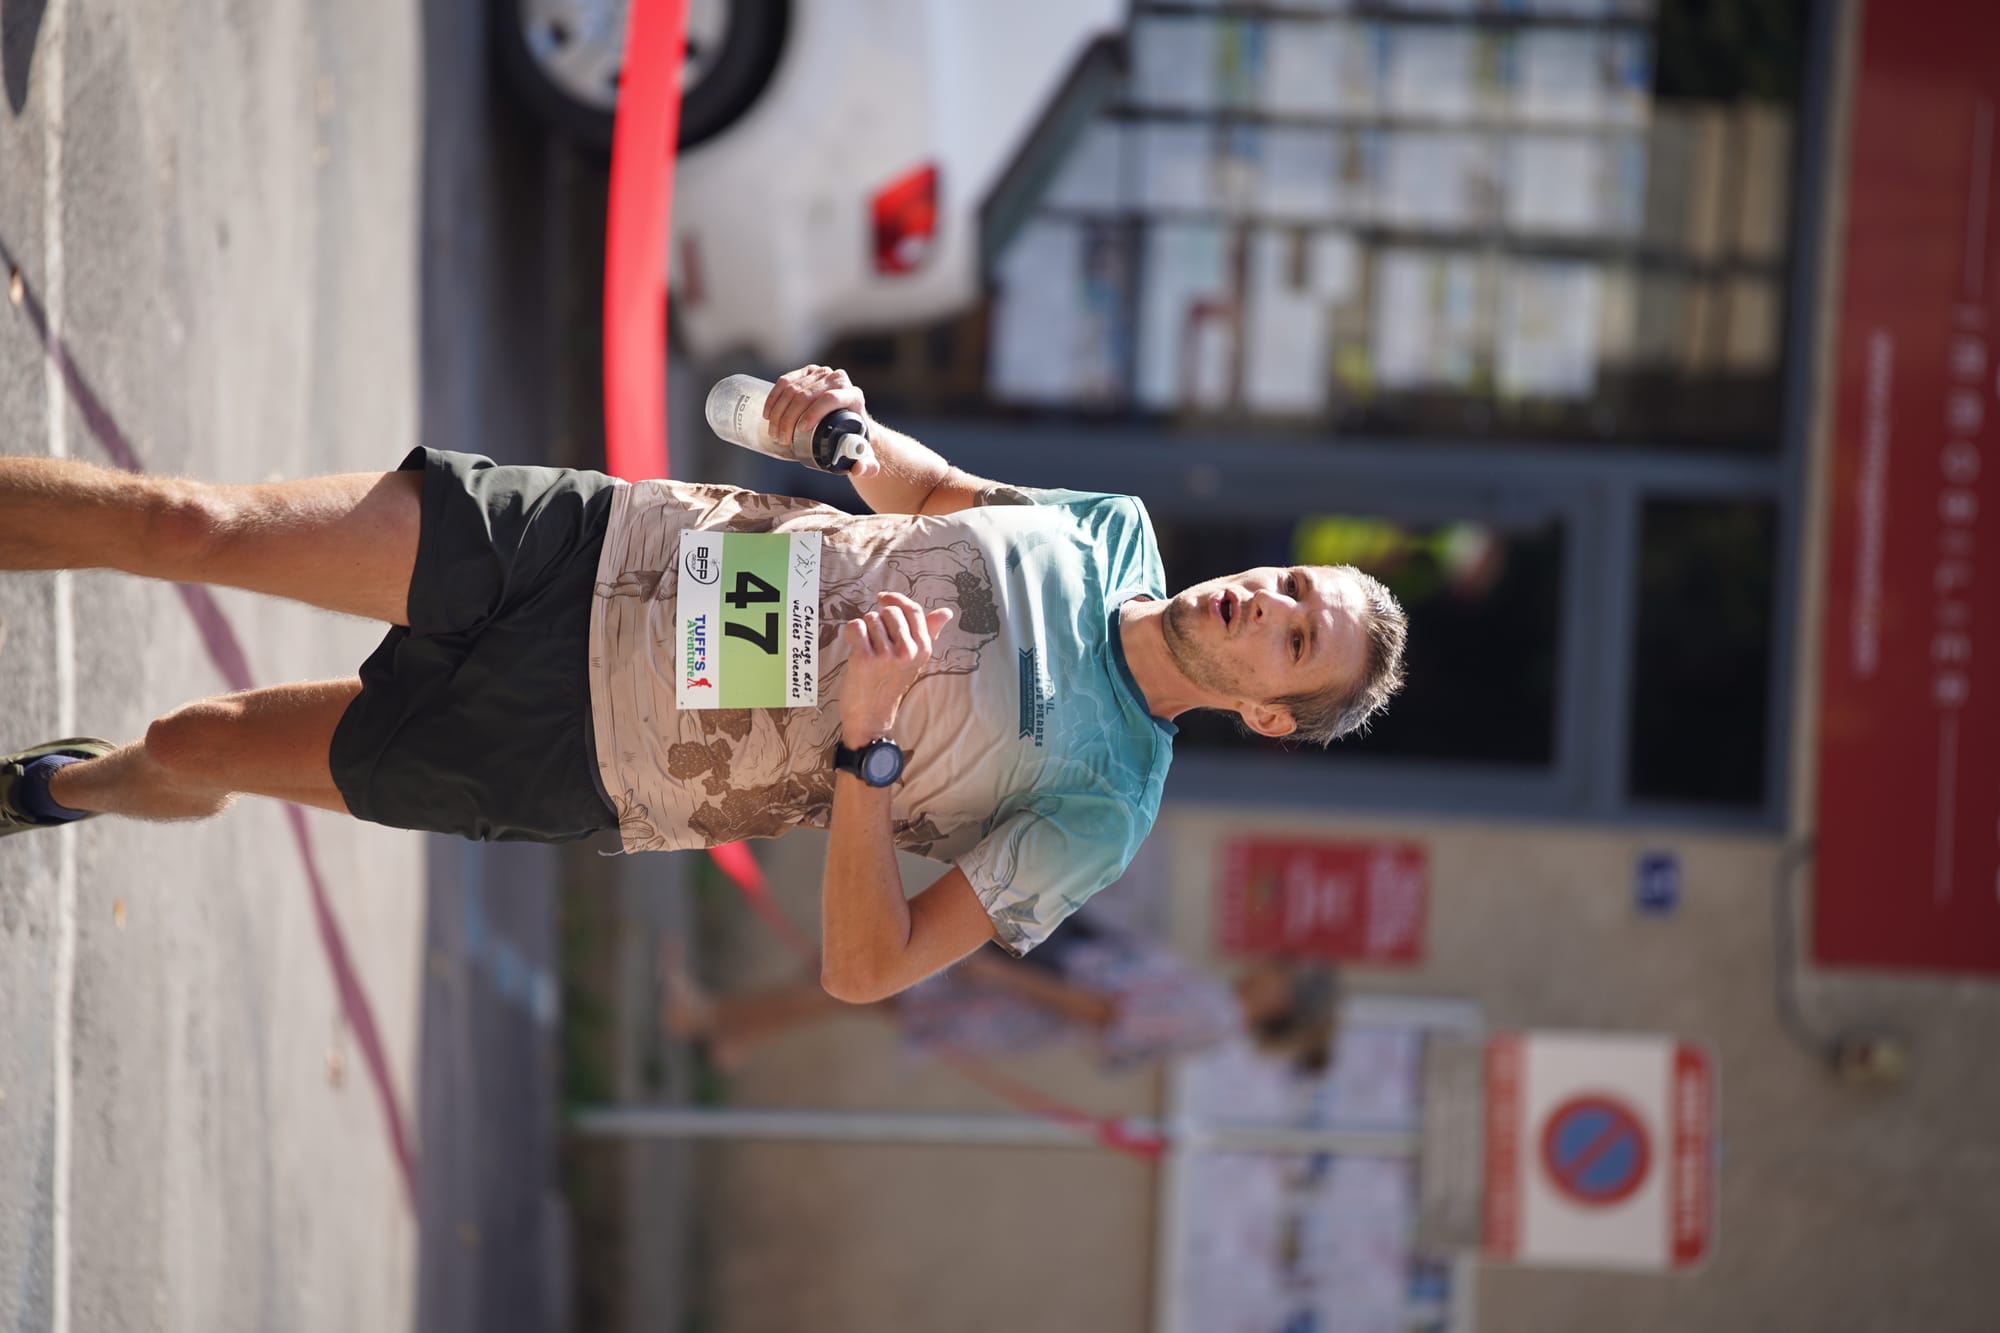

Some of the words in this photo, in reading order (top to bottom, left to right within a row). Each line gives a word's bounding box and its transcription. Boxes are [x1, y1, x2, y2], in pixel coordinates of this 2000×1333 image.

[695, 547, 709, 579] BFP
[725, 571, 780, 655] 47
[792, 600, 803, 640] vallées
[801, 605, 814, 665] Challenge
[687, 619, 698, 677] Aventure
[695, 614, 706, 672] TUFF'S
[792, 647, 802, 699] cévenoles
[803, 672, 813, 692] des
[1036, 687, 1044, 700] DE
[1035, 704, 1045, 747] PIERRES
